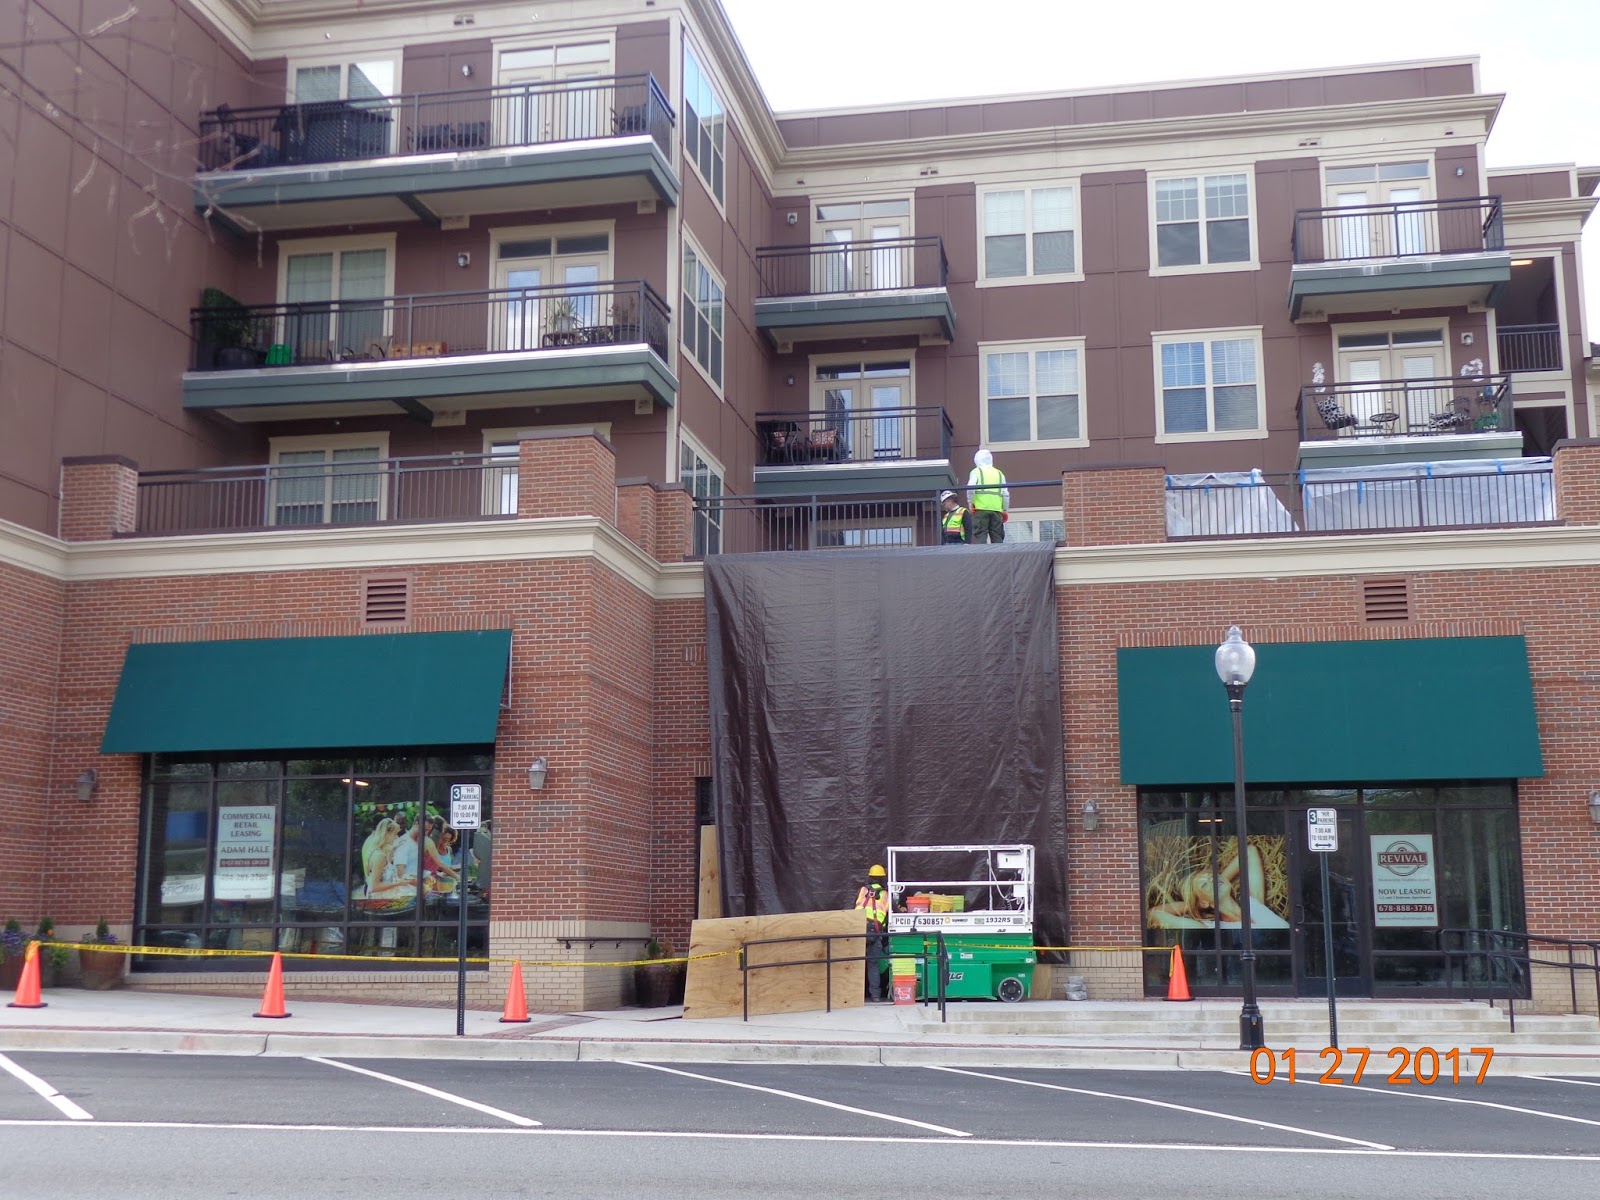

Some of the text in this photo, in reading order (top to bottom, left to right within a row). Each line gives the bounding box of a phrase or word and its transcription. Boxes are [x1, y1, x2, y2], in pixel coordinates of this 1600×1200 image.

[453, 788, 460, 799] 3
[222, 812, 272, 820] COMMERCIAL
[1309, 811, 1317, 823] 3
[233, 821, 259, 829] RETAIL
[1380, 854, 1425, 863] REVIVAL
[1378, 904, 1433, 912] 678-888-3736
[917, 917, 944, 925] 630857
